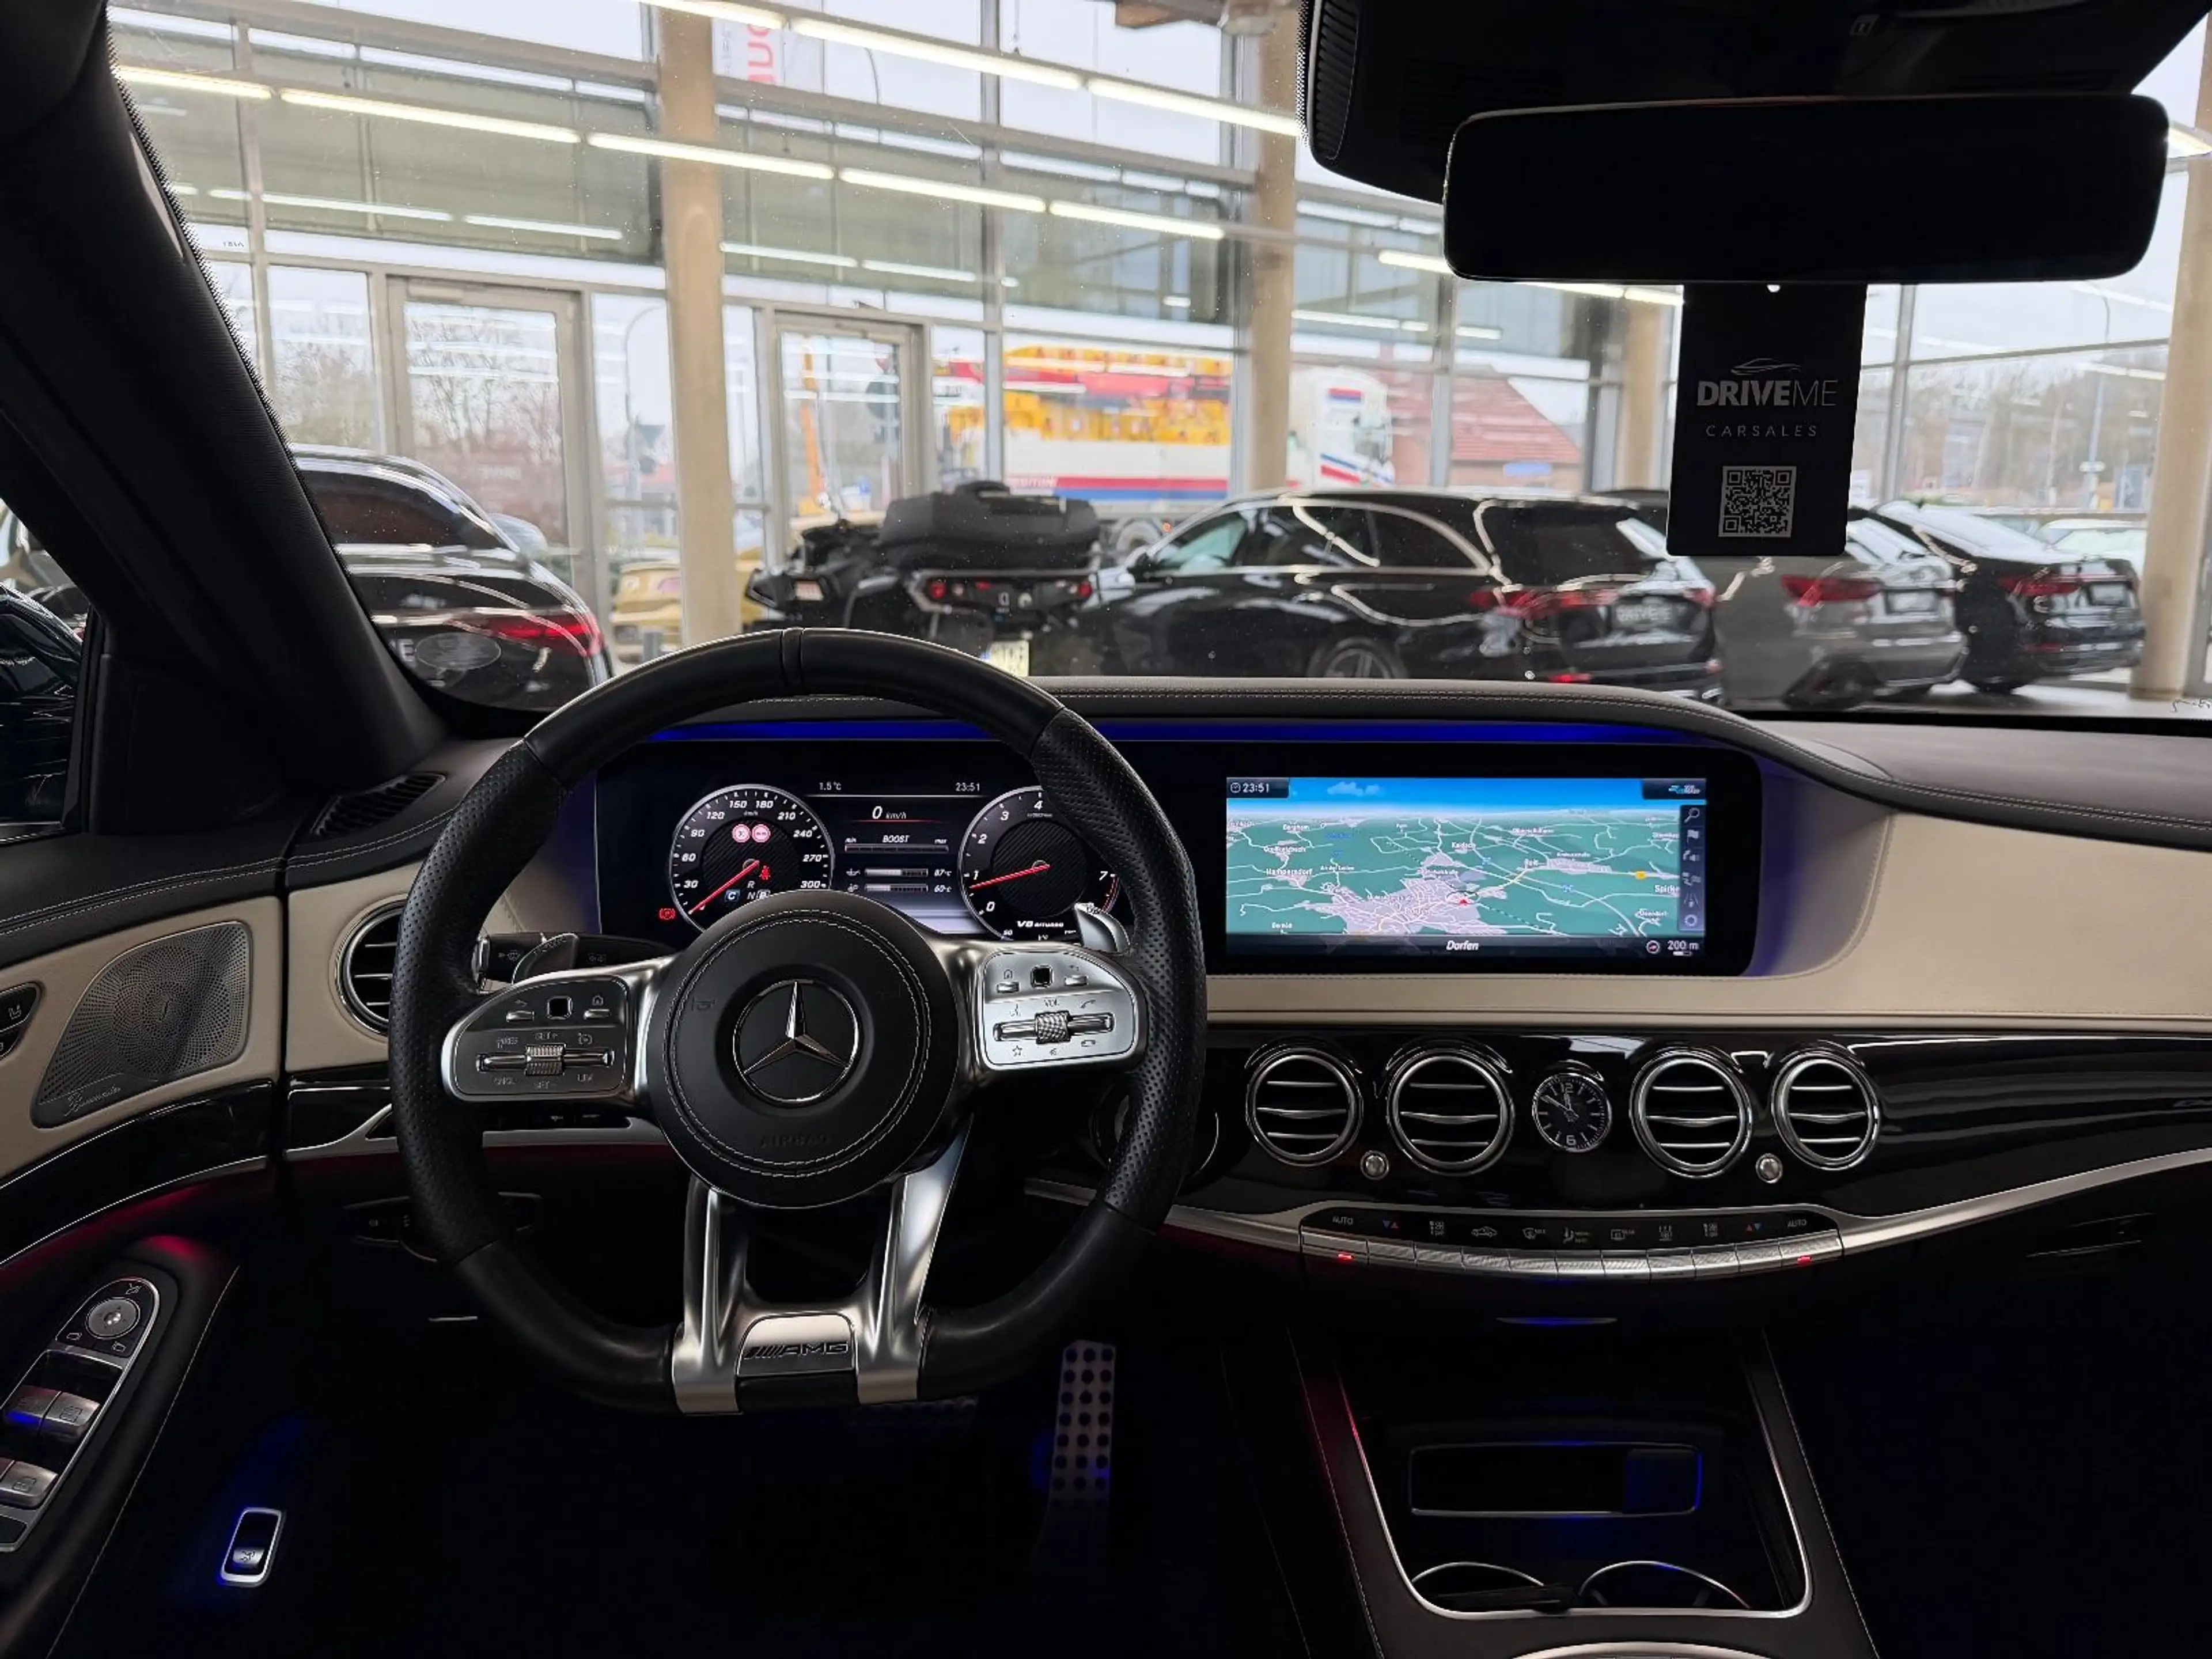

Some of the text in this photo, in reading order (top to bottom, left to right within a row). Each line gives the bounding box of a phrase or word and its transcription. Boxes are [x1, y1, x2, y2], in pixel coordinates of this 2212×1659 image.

[1696, 380, 1838, 406] DRIVEME
[1706, 425, 1817, 437] CARSALES
[955, 782, 980, 791] 23:51
[1242, 783, 1270, 793] 23:51
[1034, 801, 1043, 809] 4
[707, 812, 725, 820] 120
[778, 812, 796, 820] 210
[872, 806, 882, 819] 0
[1000, 812, 1009, 821] 3
[793, 830, 813, 838] 240
[978, 834, 987, 844] 2
[682, 854, 696, 862] 60
[802, 854, 822, 862] 270
[974, 871, 978, 880] 1
[1099, 871, 1108, 880] 7
[684, 880, 698, 888] 30
[986, 902, 995, 911] 0
[1446, 940, 1479, 950] Dorfen
[1668, 940, 1686, 950] 200
[1560, 1082, 1574, 1093] 12
[1566, 1135, 1577, 1146] 6
[1332, 1216, 1353, 1225] AUTO
[1787, 1219, 1808, 1228] AUTO
